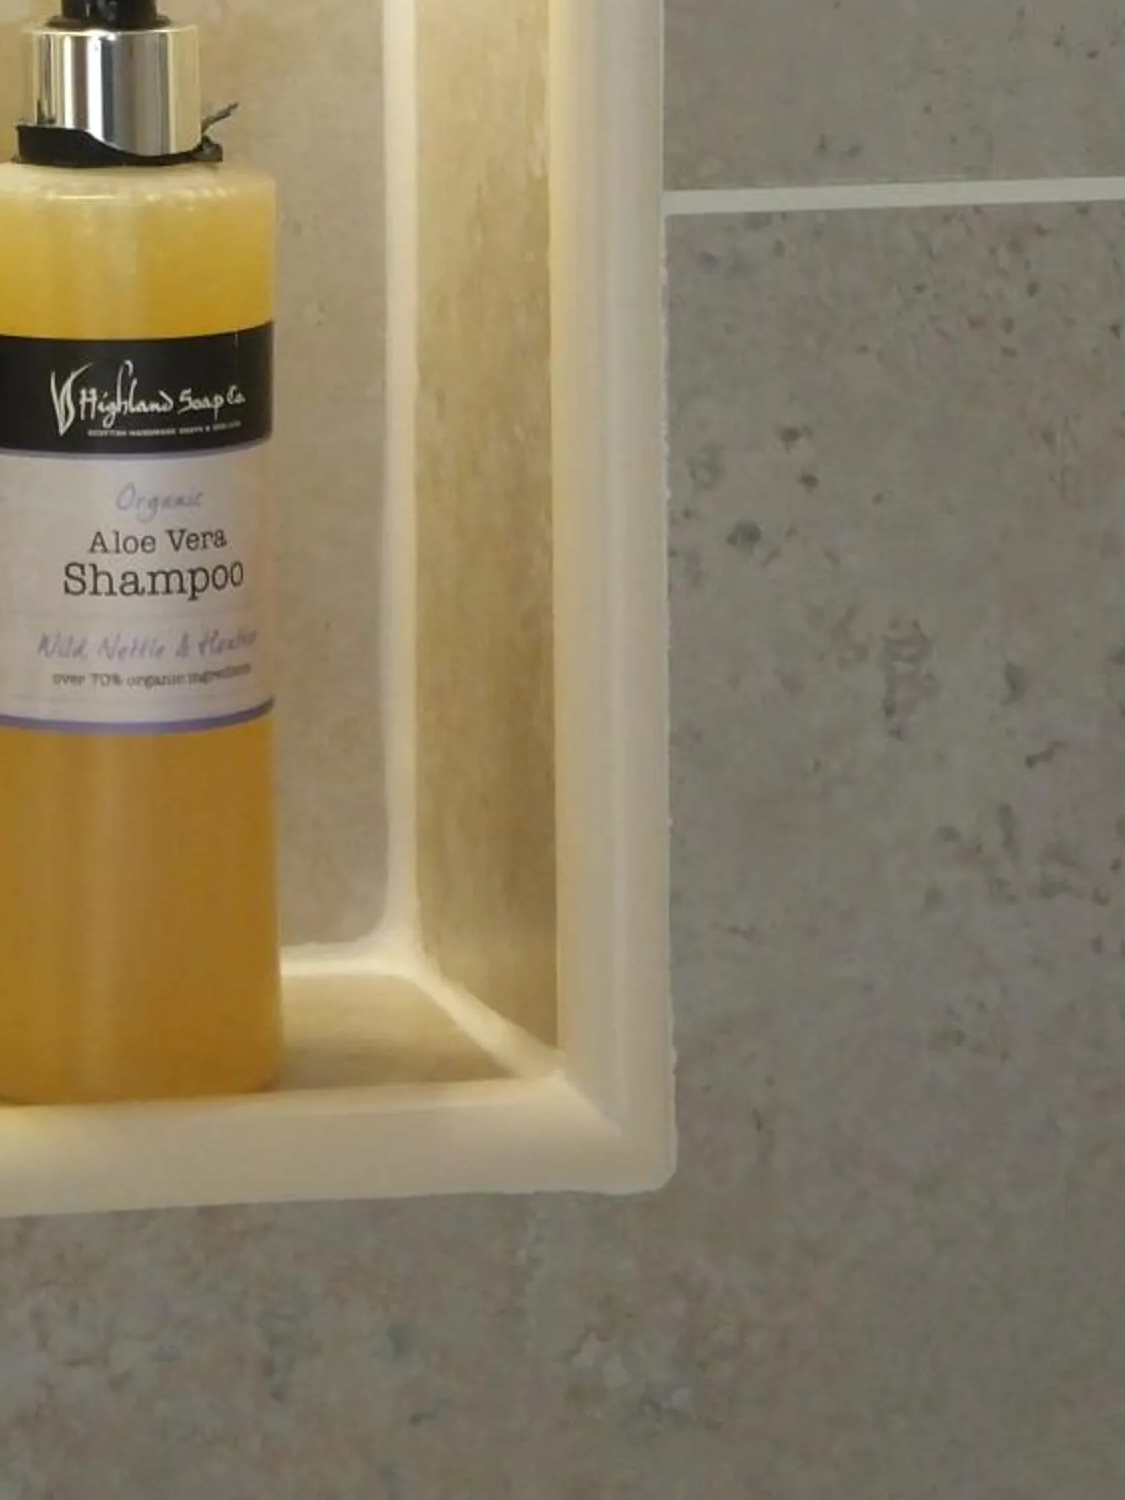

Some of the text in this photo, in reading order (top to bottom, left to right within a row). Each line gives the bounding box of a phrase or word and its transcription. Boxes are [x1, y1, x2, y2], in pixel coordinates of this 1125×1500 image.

[79, 360, 174, 429] Highland
[177, 388, 225, 421] Soap
[115, 482, 205, 523] Organic
[88, 528, 228, 554] Aloe Vera
[63, 561, 244, 601] Shampoo
[52, 673, 86, 687] over
[126, 672, 185, 690] organic
